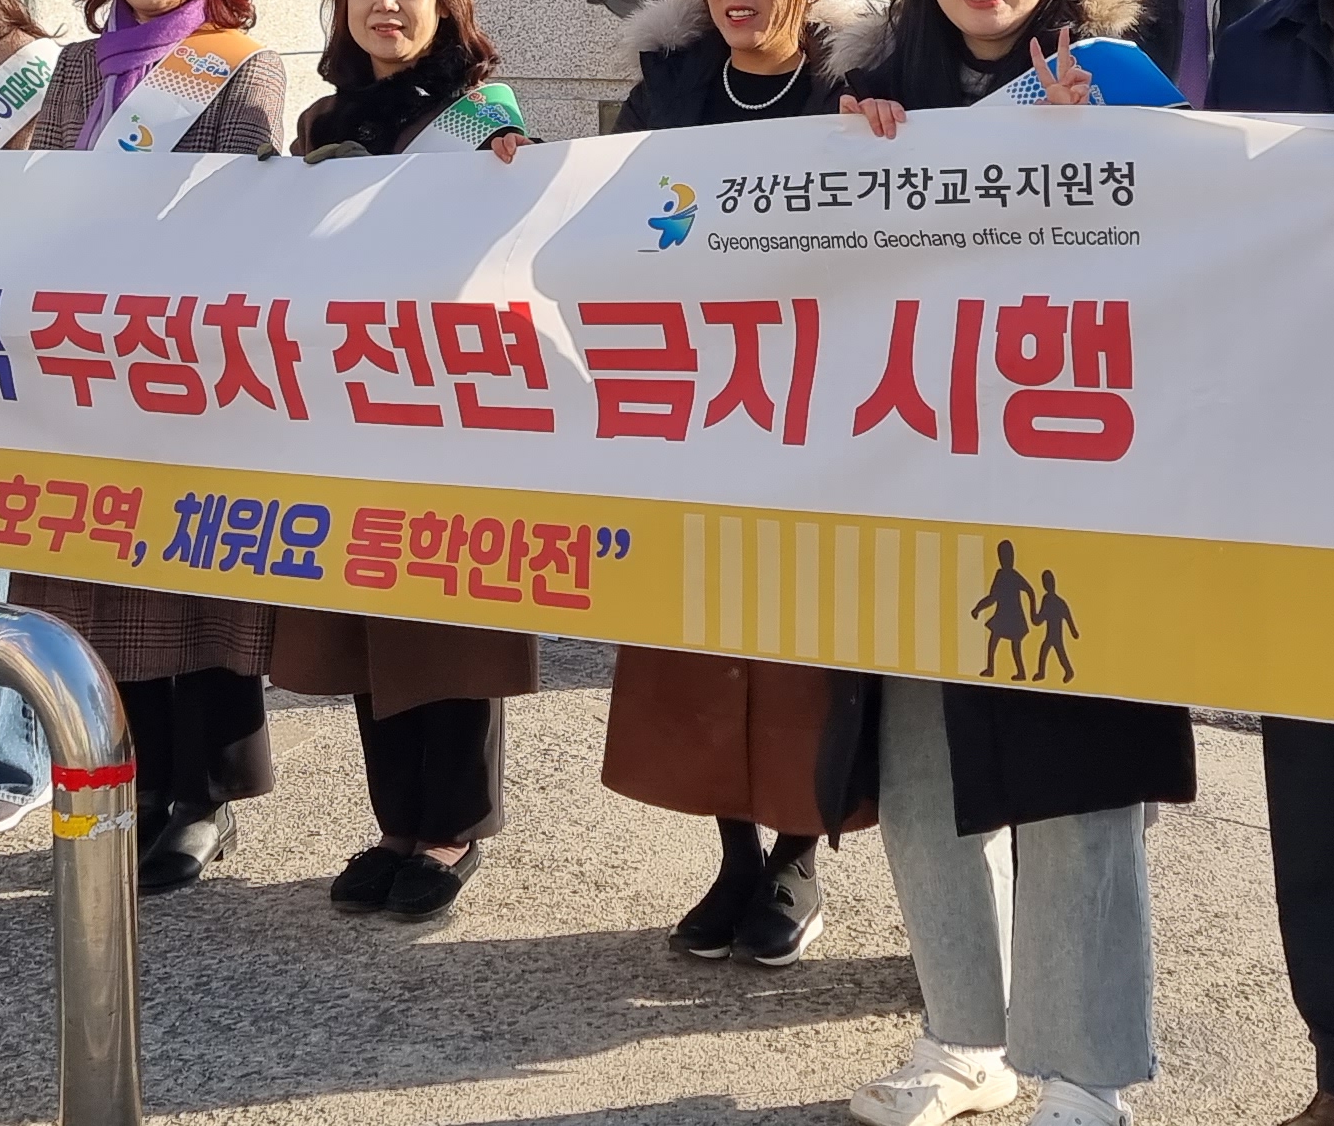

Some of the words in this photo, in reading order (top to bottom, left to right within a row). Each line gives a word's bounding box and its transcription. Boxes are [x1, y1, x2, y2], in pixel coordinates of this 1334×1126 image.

[708, 231, 868, 253] Gyeongsangnamdo
[874, 228, 966, 251] Geochang
[972, 227, 1023, 247] office
[1028, 226, 1046, 246] of
[1051, 226, 1140, 246] Ecucation
[29, 291, 310, 422] 주정차
[325, 299, 555, 434] 전면
[577, 298, 821, 447] 금지
[851, 295, 1135, 463] 시행
[162, 491, 332, 581] 채워요
